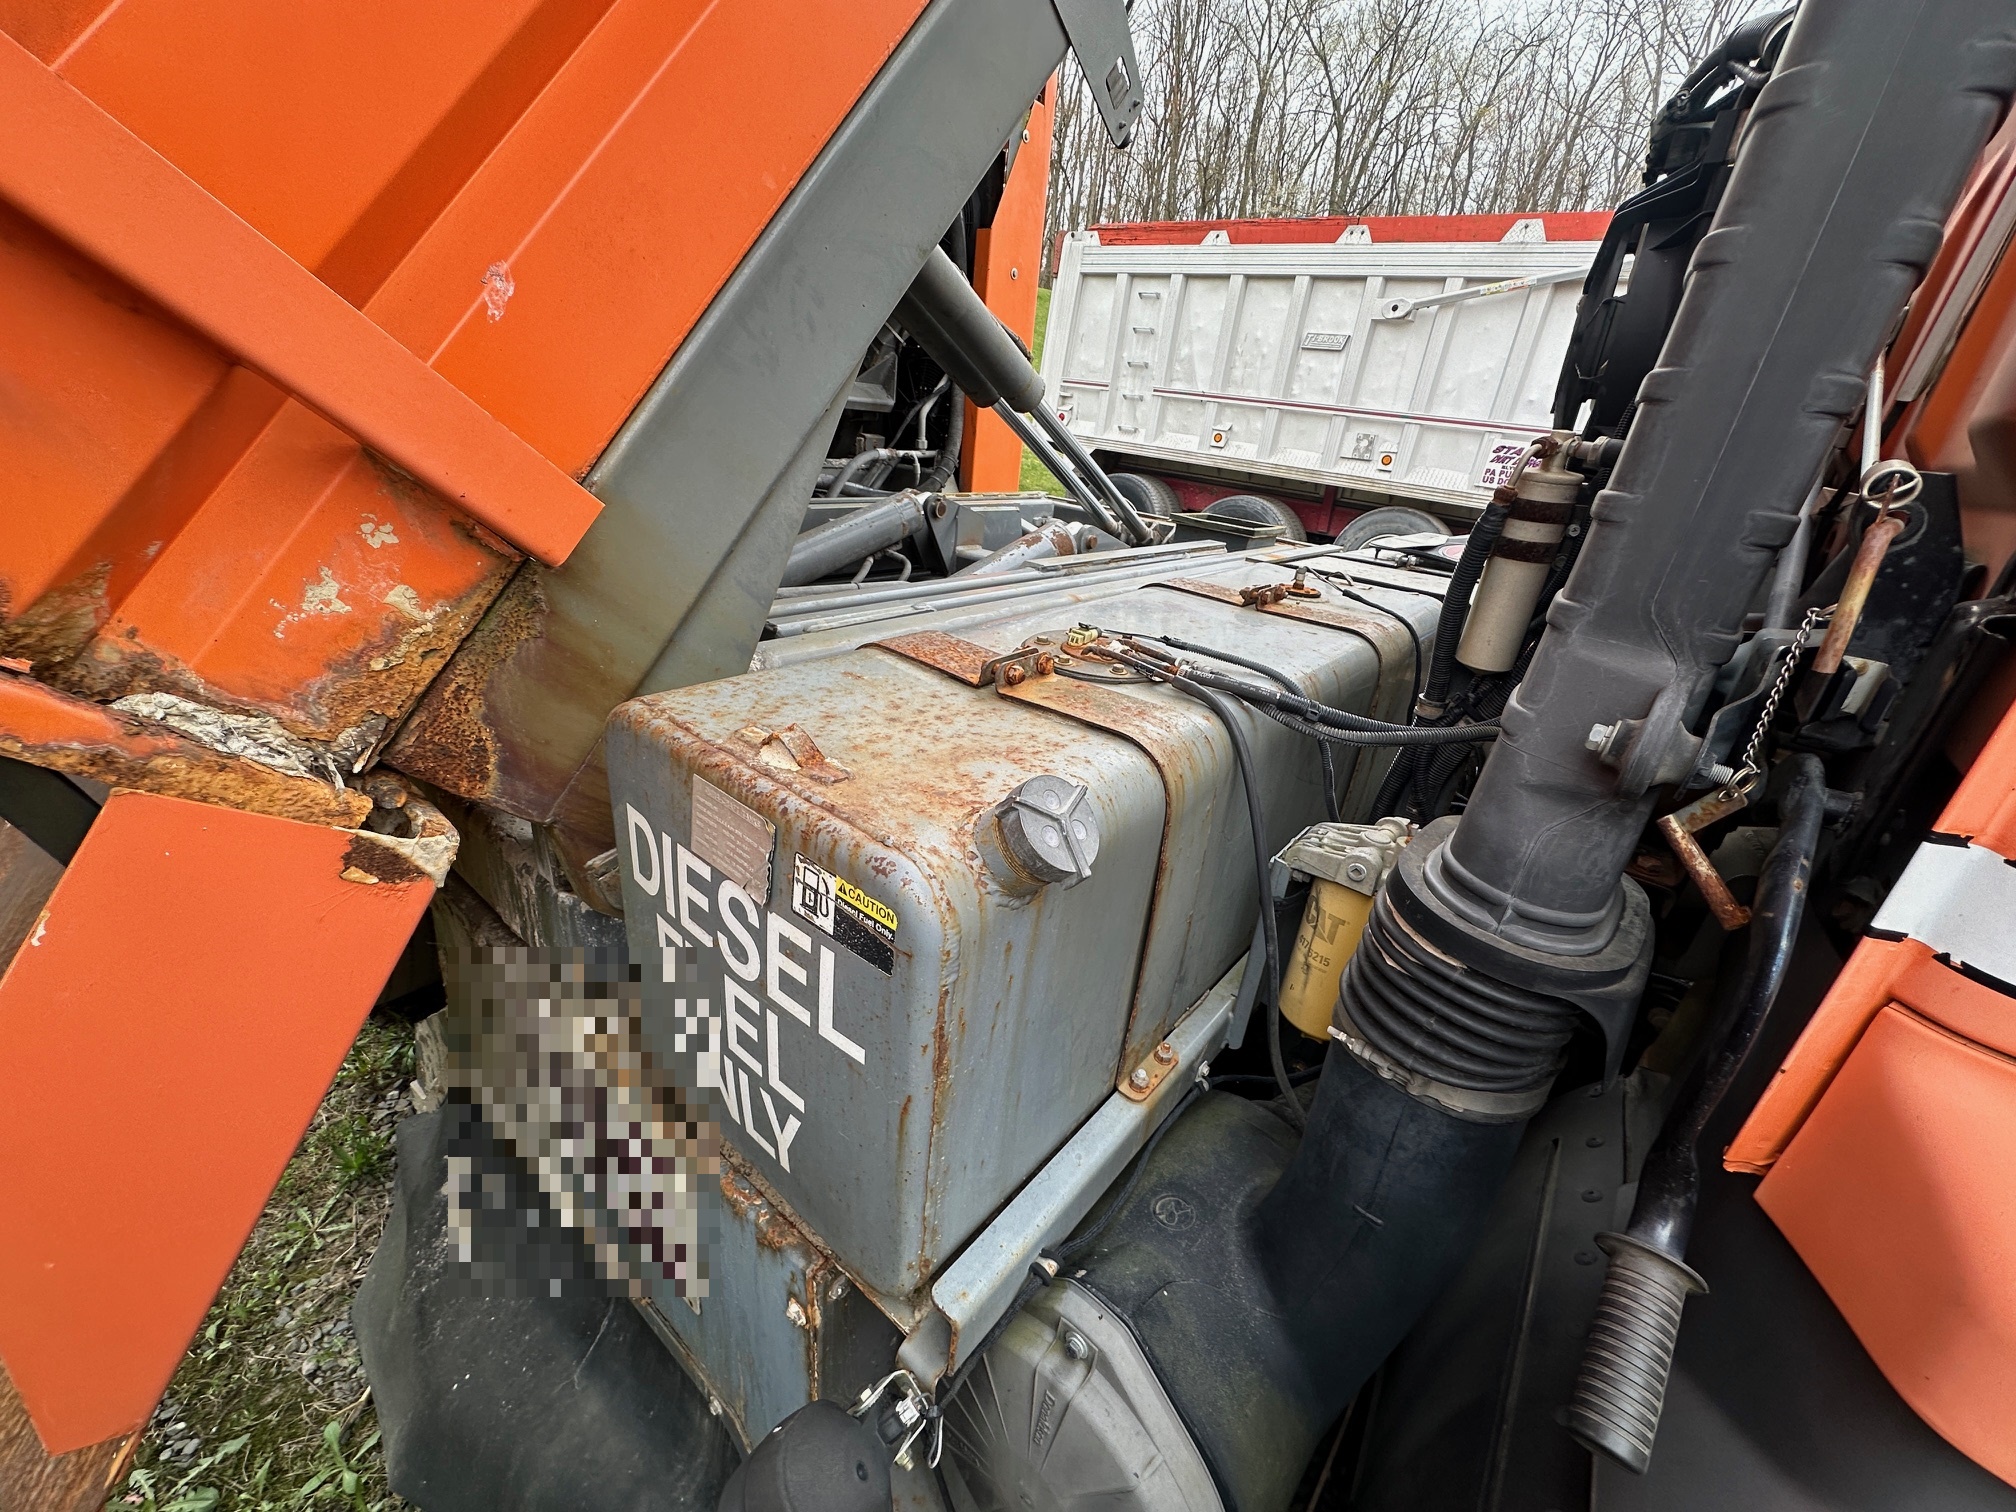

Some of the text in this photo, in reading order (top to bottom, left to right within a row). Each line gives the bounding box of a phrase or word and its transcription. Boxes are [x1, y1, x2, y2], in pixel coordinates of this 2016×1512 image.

[1482, 476, 1495, 484] US
[1484, 468, 1512, 478] PA PU
[837, 898, 894, 940] Diesel Fuel Only.
[848, 888, 895, 924] CAUTION
[1305, 894, 1347, 946] CAT
[626, 802, 866, 1066] DIESEL
